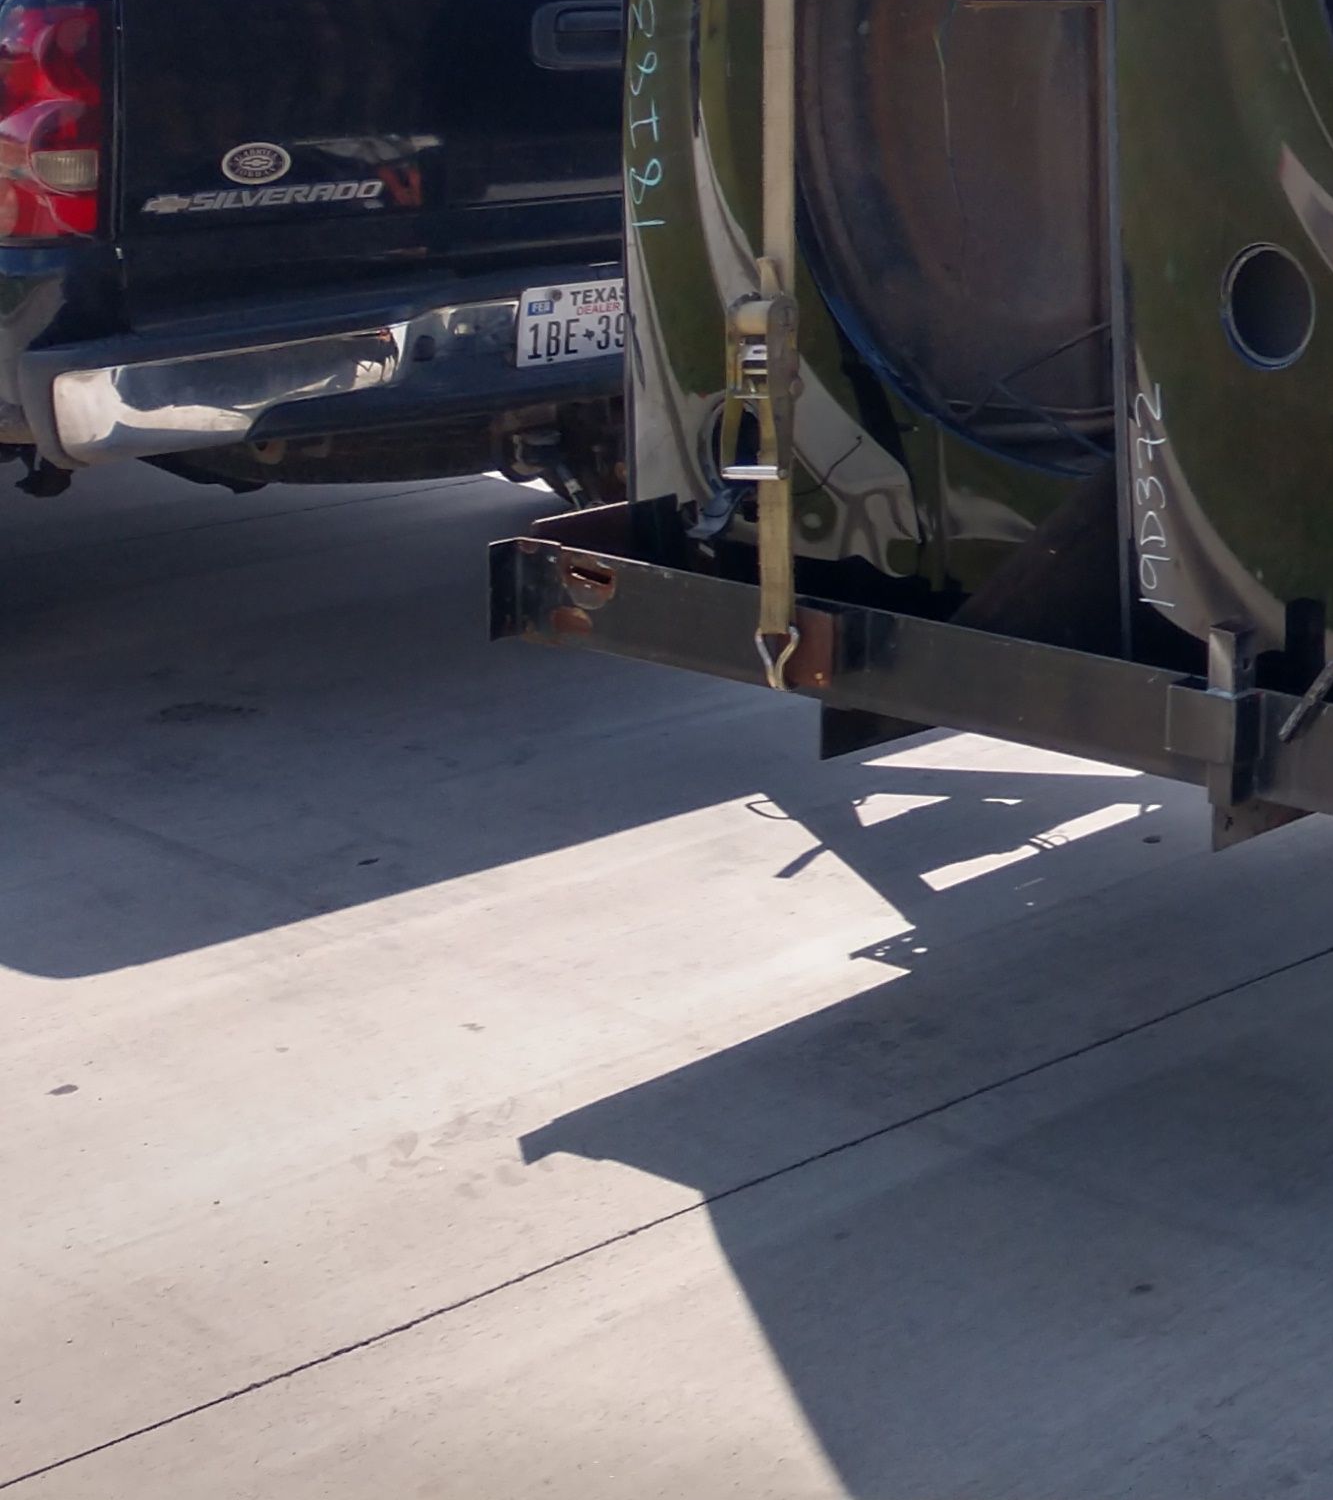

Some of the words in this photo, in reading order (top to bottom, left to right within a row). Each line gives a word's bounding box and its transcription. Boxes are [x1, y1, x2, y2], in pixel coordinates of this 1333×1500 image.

[188, 180, 384, 211] SILVERADO
[577, 302, 622, 315] DEALER
[1133, 383, 1175, 608] 19D372
